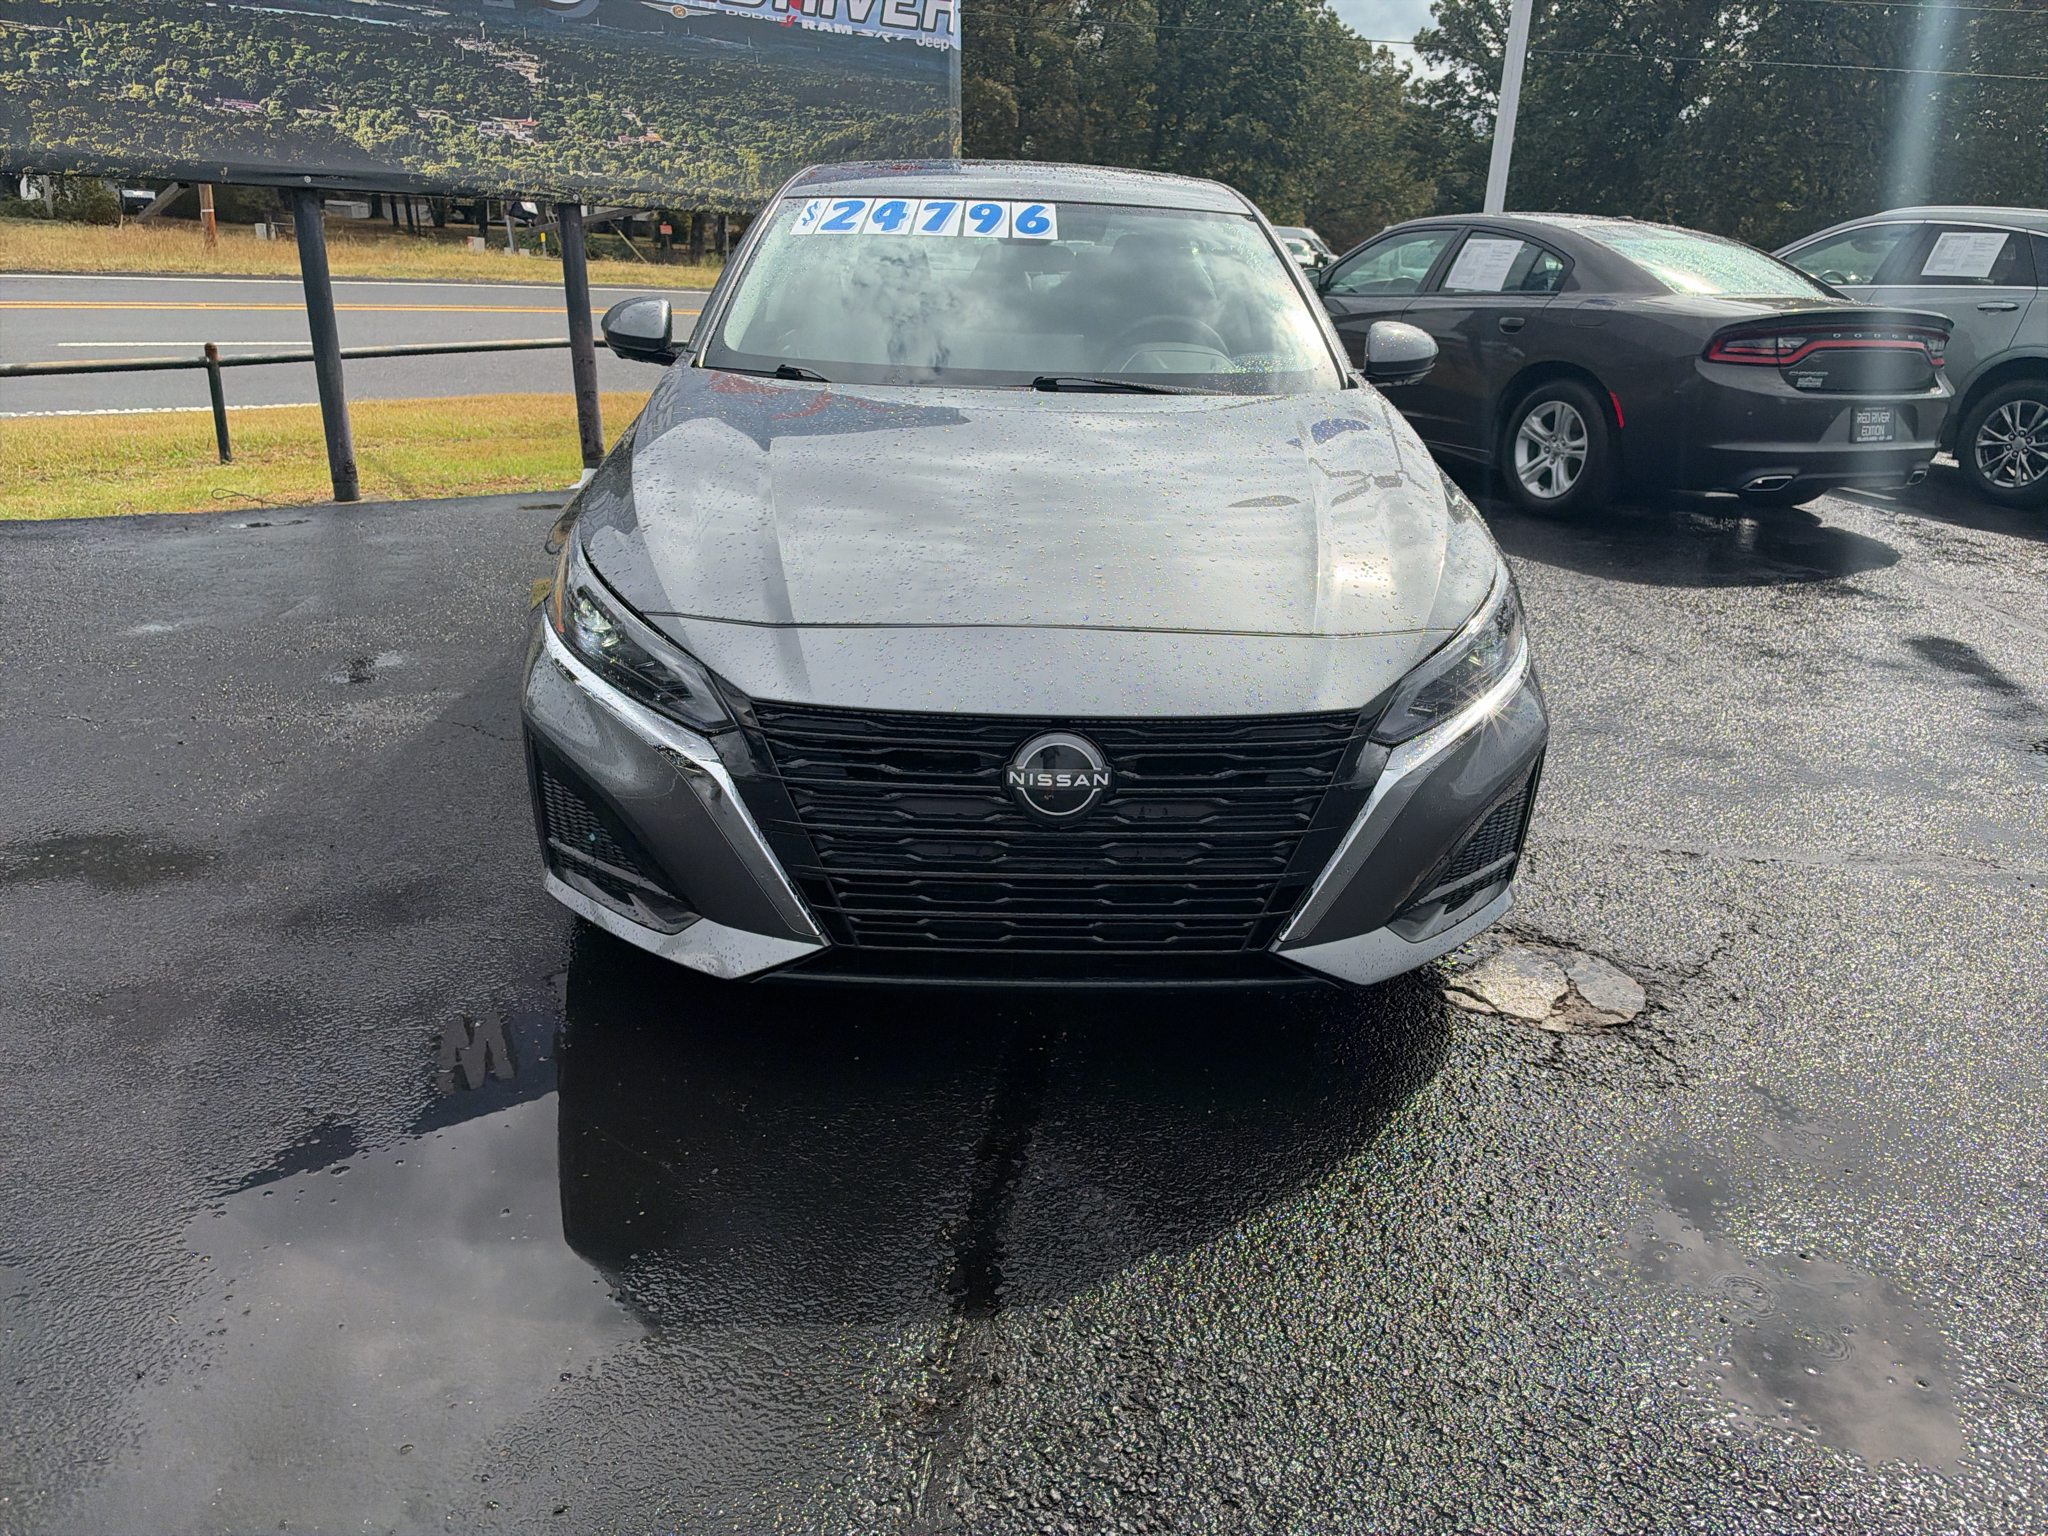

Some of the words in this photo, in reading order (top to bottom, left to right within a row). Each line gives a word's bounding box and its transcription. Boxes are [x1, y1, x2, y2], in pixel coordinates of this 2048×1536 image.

[725, 9, 787, 23] DODGE
[802, 19, 853, 36] RAM
[856, 29, 911, 43] SRT
[916, 33, 950, 52] Jeep
[801, 199, 1054, 236] $24796
[1857, 412, 1870, 423] RED
[1871, 411, 1890, 423] RIVER
[1861, 425, 1885, 436] EDITION
[1009, 771, 1109, 787] NISSAN
